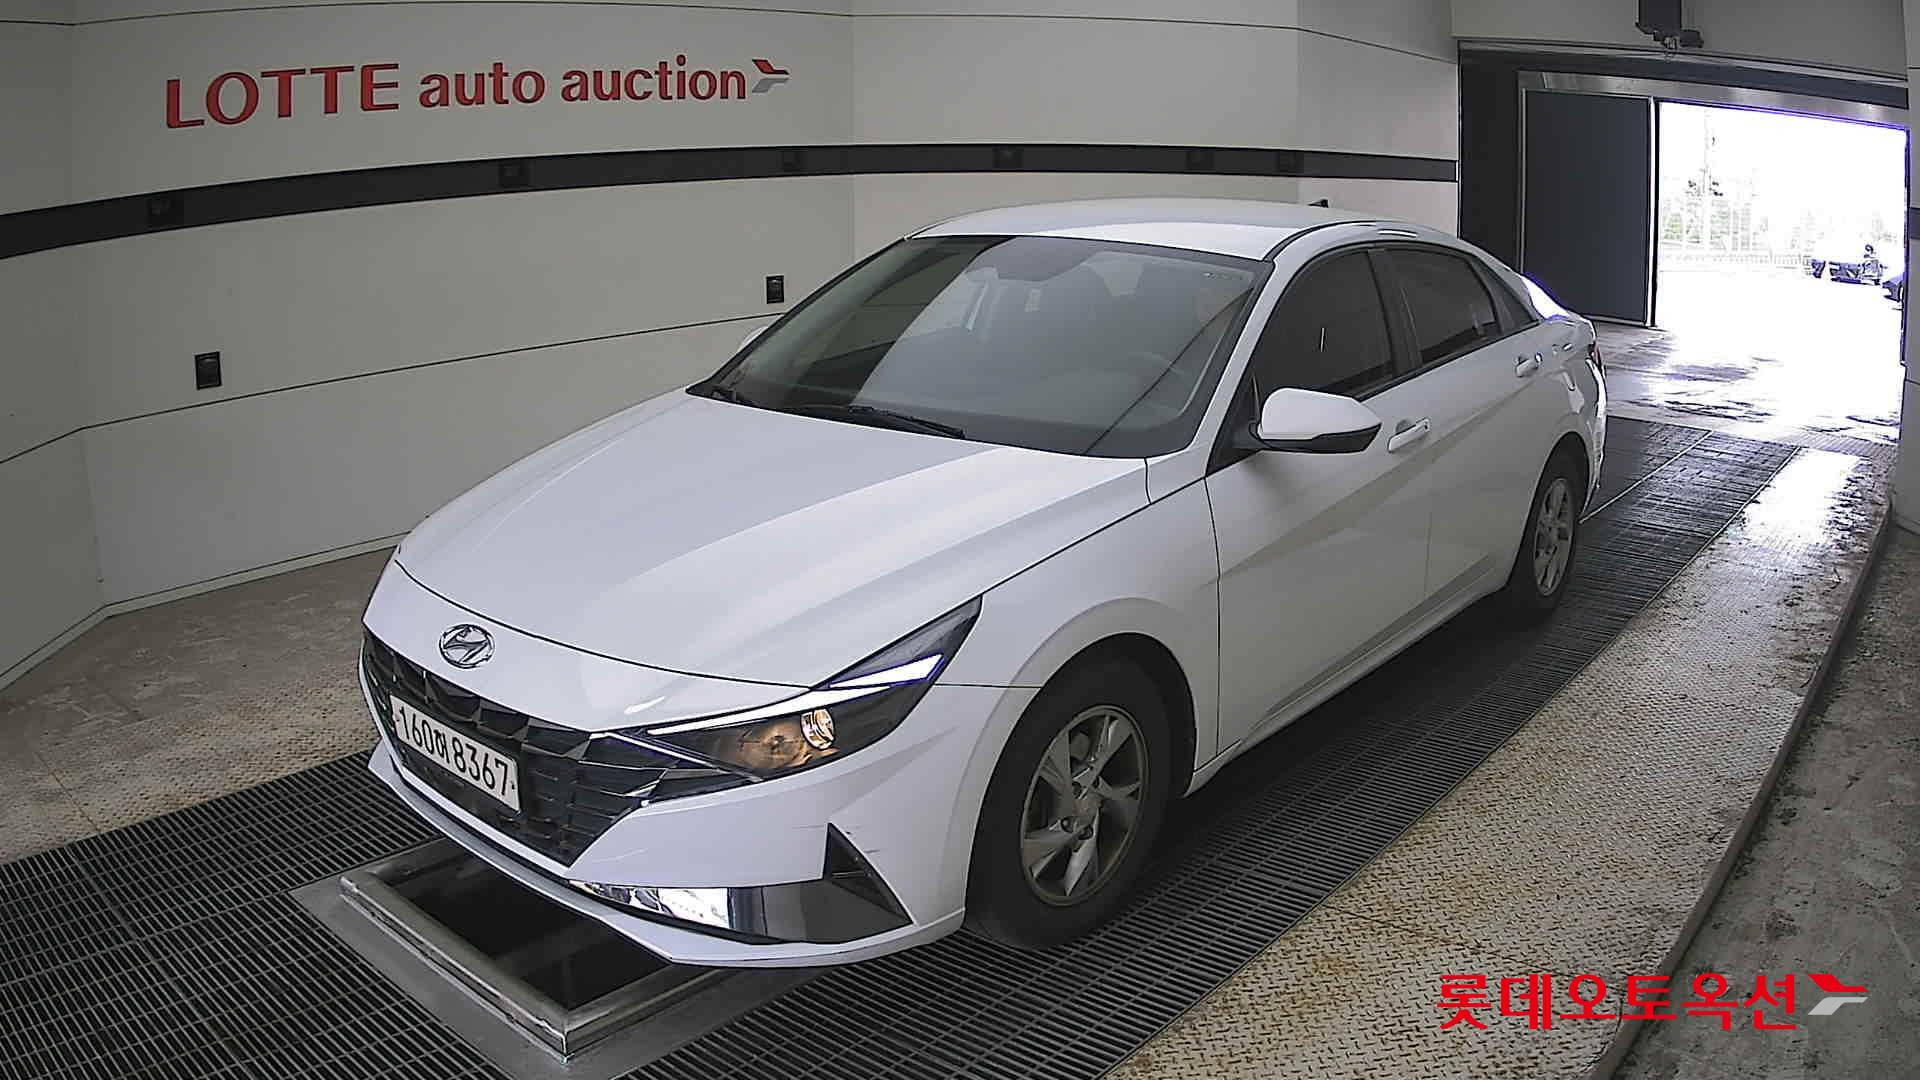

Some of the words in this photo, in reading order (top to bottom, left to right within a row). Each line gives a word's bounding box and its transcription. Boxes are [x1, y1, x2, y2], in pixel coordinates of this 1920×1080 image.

[166, 64, 399, 128] LOTTE
[420, 62, 545, 108] auto
[562, 55, 747, 103] auction
